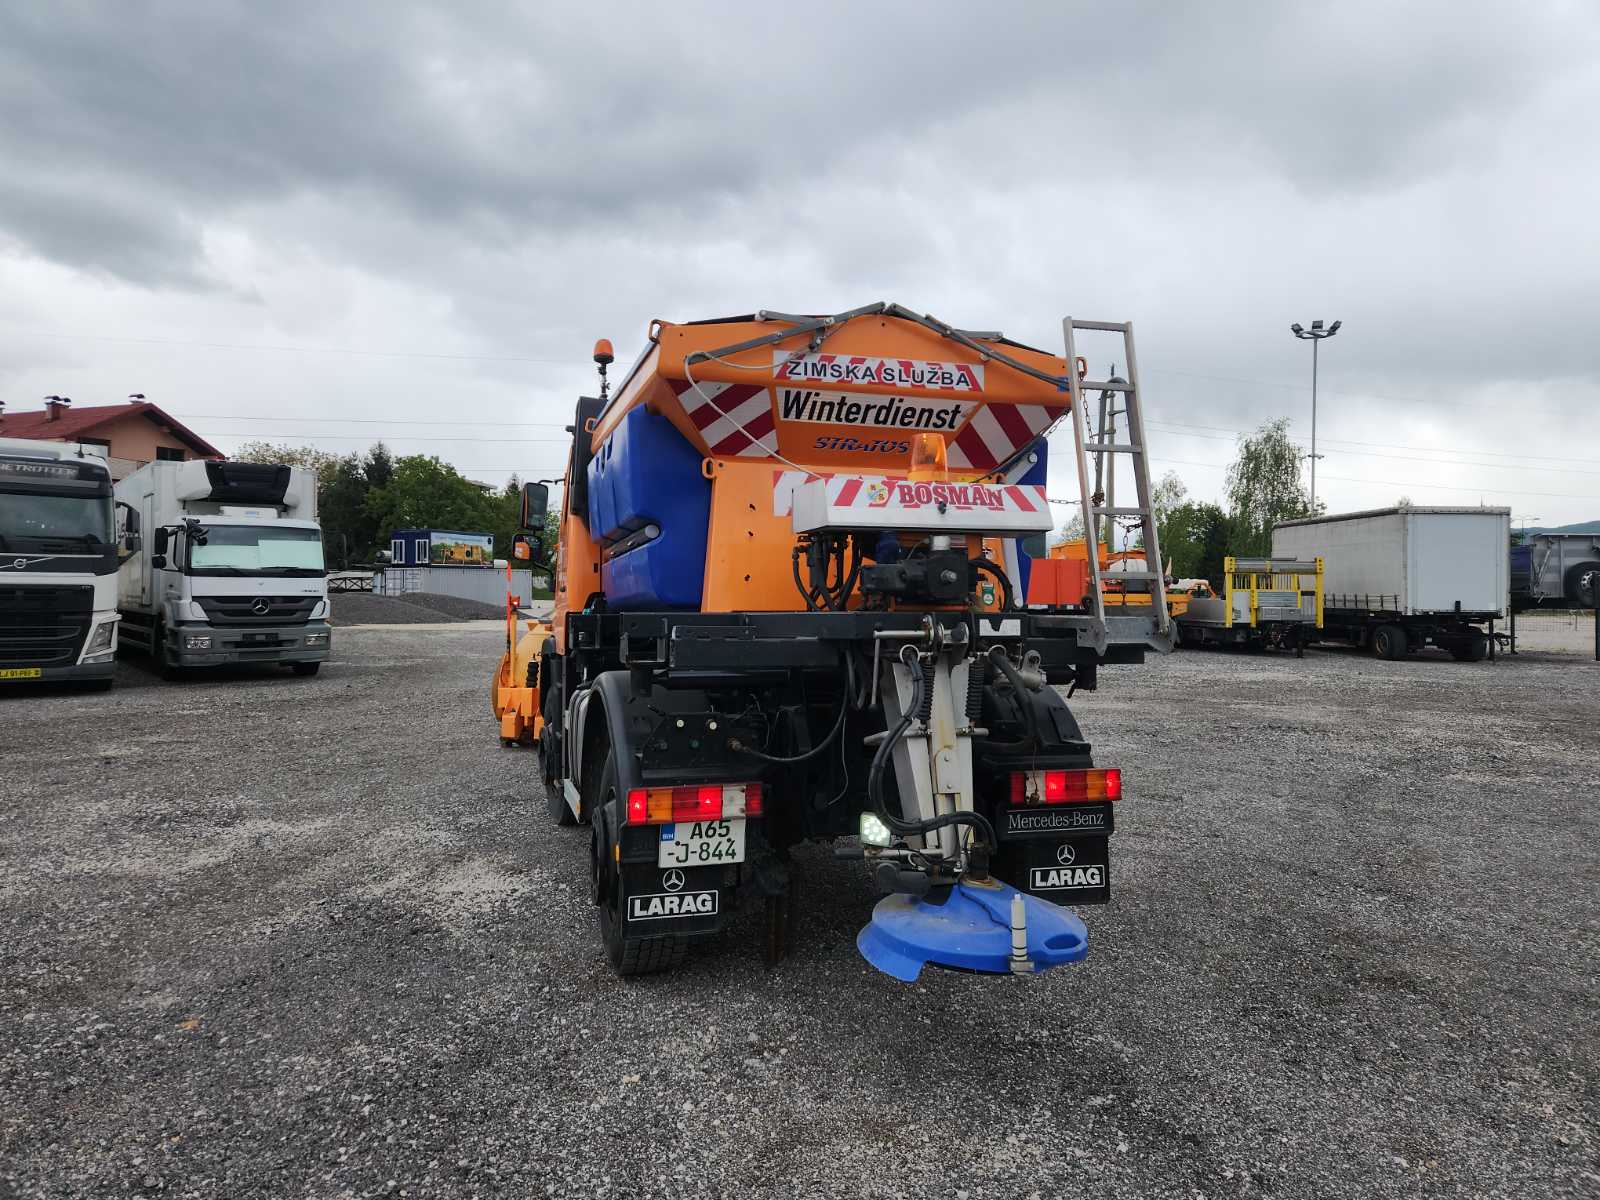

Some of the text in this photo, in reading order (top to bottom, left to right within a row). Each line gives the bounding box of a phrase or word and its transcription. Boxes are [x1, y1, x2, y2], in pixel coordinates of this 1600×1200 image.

[787, 360, 970, 387] ZIMSKA SLUŽBA
[782, 389, 962, 430] Winterdienst
[897, 484, 1004, 506] BOSMAN
[690, 819, 732, 839] A65
[1007, 811, 1104, 829] Mercedes-Benz
[1035, 868, 1101, 887] LARAG
[634, 894, 713, 917] LARAG
